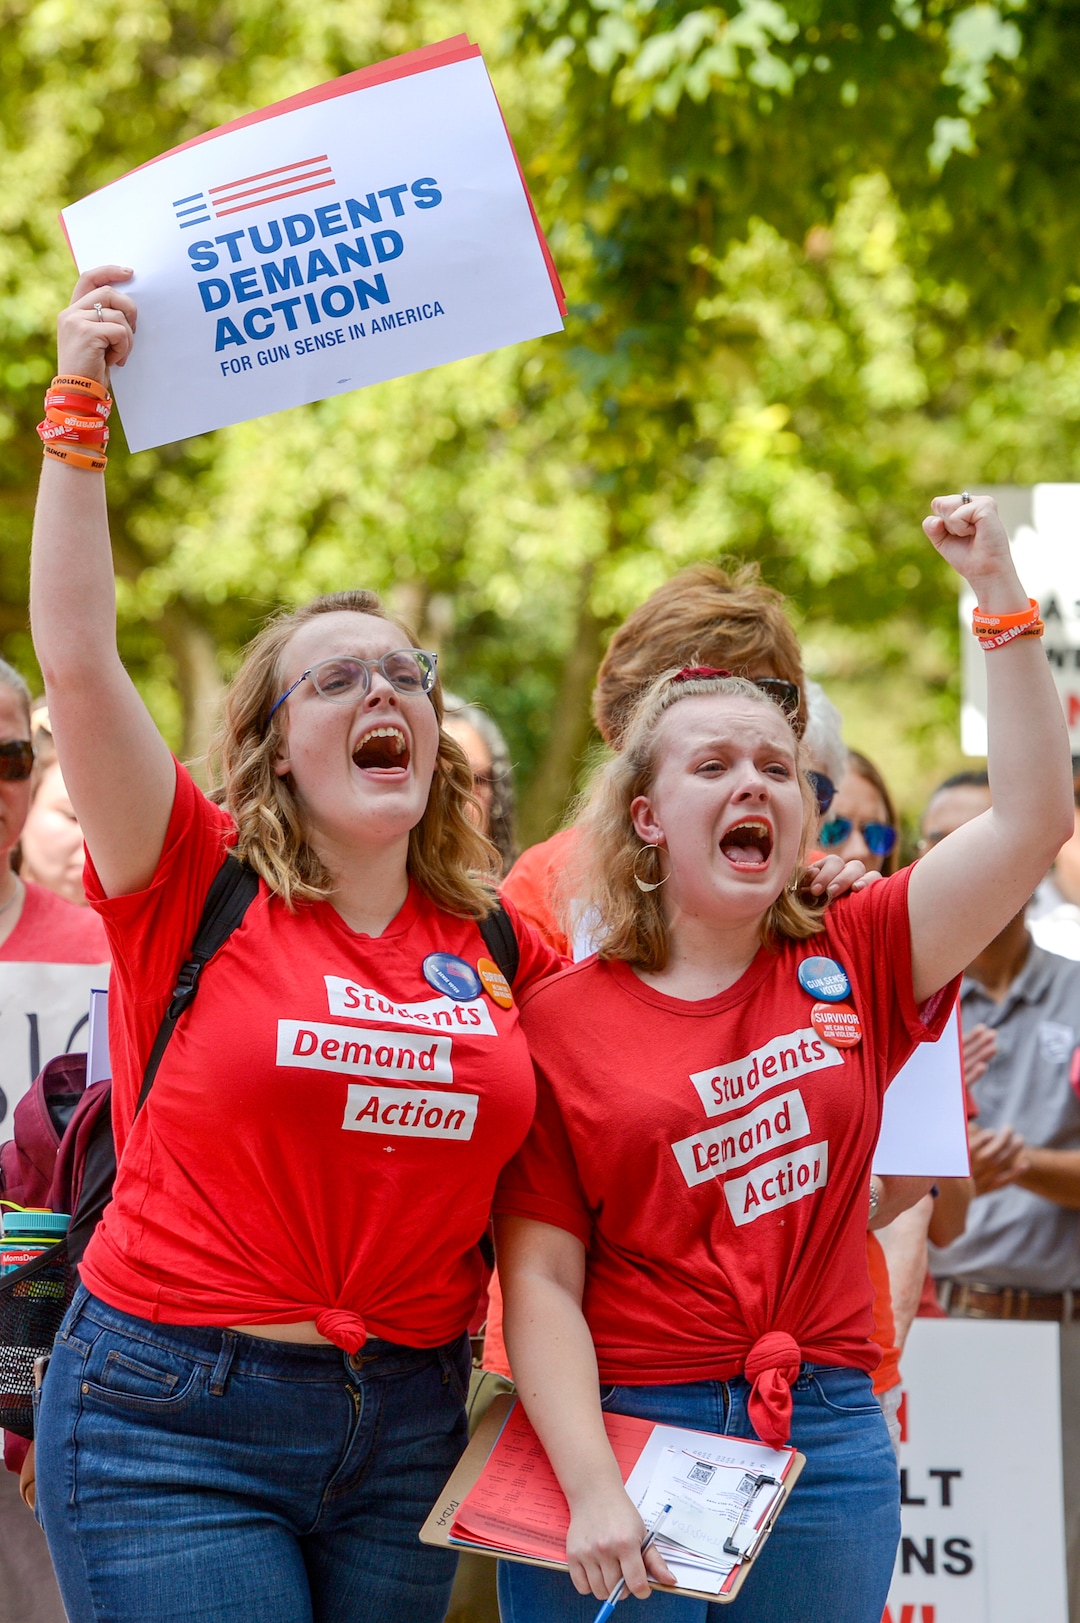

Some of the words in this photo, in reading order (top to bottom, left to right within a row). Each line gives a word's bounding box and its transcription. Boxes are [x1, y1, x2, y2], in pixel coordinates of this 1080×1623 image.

[187, 177, 443, 272] STUDENTS
[197, 229, 404, 312] DEMAND
[214, 273, 391, 352] ACTION
[220, 355, 253, 377] FOR
[257, 344, 290, 367] GUN
[295, 328, 346, 356] SENSE
[348, 322, 366, 341] IN
[371, 300, 445, 335] AMERICA
[806, 978, 824, 989] GUN
[824, 973, 849, 986] SENSE
[819, 984, 844, 995] VOTER
[344, 986, 482, 1026] Students
[814, 1013, 860, 1024] SURVIVOR
[292, 1029, 439, 1071] Demand
[710, 1038, 826, 1105] Students
[355, 1096, 466, 1130] Action
[900, 1469, 962, 1507] LT
[902, 1537, 974, 1577] NS
